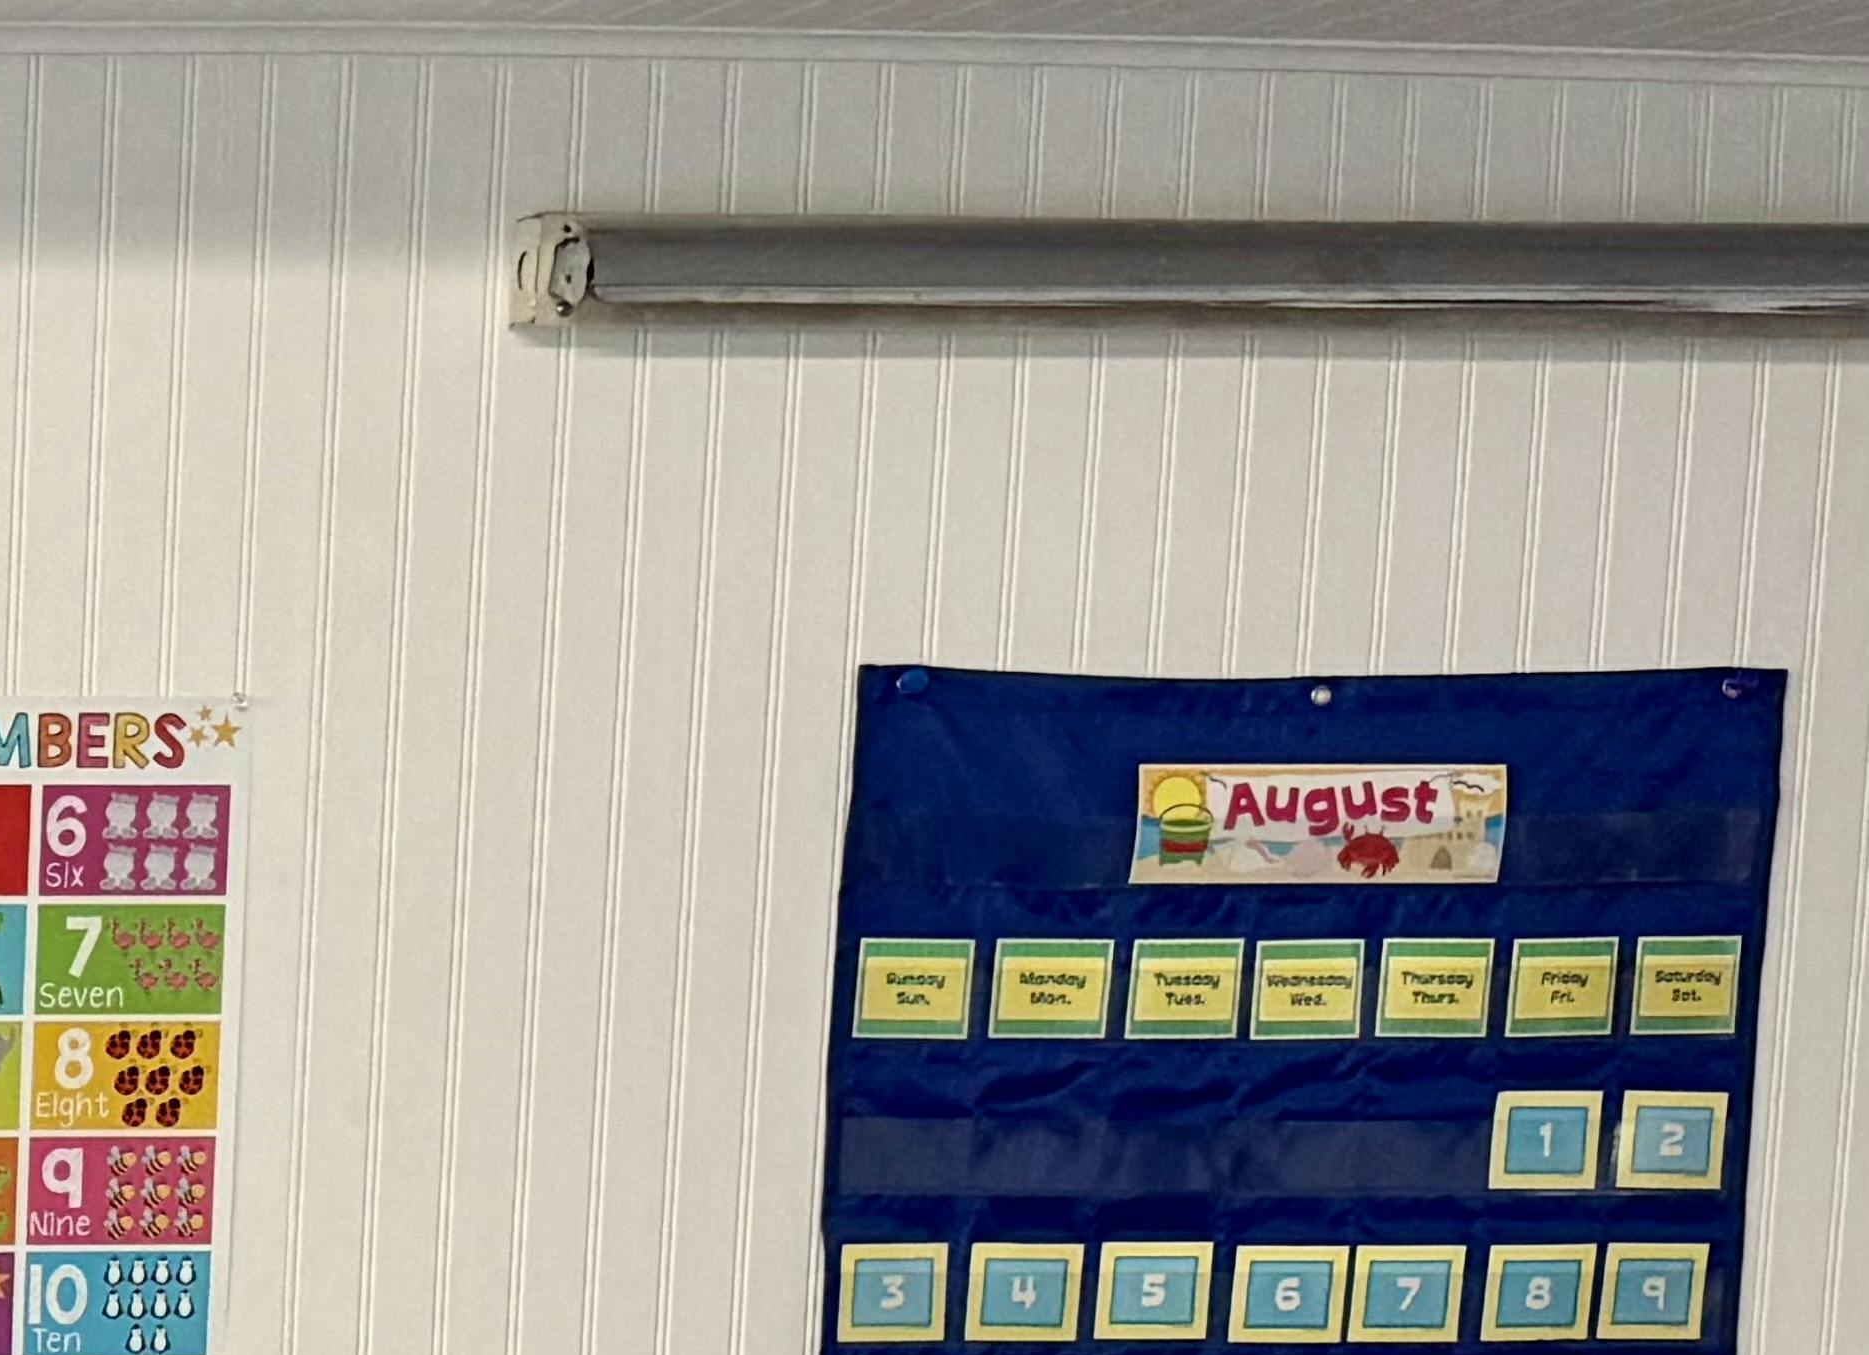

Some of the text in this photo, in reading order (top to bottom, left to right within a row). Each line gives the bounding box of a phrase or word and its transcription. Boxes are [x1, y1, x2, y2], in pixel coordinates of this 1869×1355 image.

[1224, 779, 1439, 837] August
[45, 795, 88, 857] 6
[45, 861, 85, 889] Six
[65, 915, 103, 979] 7
[39, 983, 125, 1009] Seven
[54, 1027, 94, 1090] 8
[34, 1091, 110, 1127] Eight
[1538, 1121, 1553, 1157] 1
[1659, 1122, 1684, 1156] 2
[41, 1147, 84, 1209] 9
[29, 1210, 91, 1238] Nine
[28, 1263, 87, 1325] 10
[880, 1274, 904, 1309] 3
[1011, 1276, 1037, 1309] 4
[1141, 1274, 1166, 1307] 5
[1275, 1277, 1302, 1311] 6
[1396, 1277, 1422, 1310] 7
[1525, 1277, 1552, 1310] 8
[1642, 1276, 1666, 1310] 9
[32, 1327, 82, 1353] Ten
